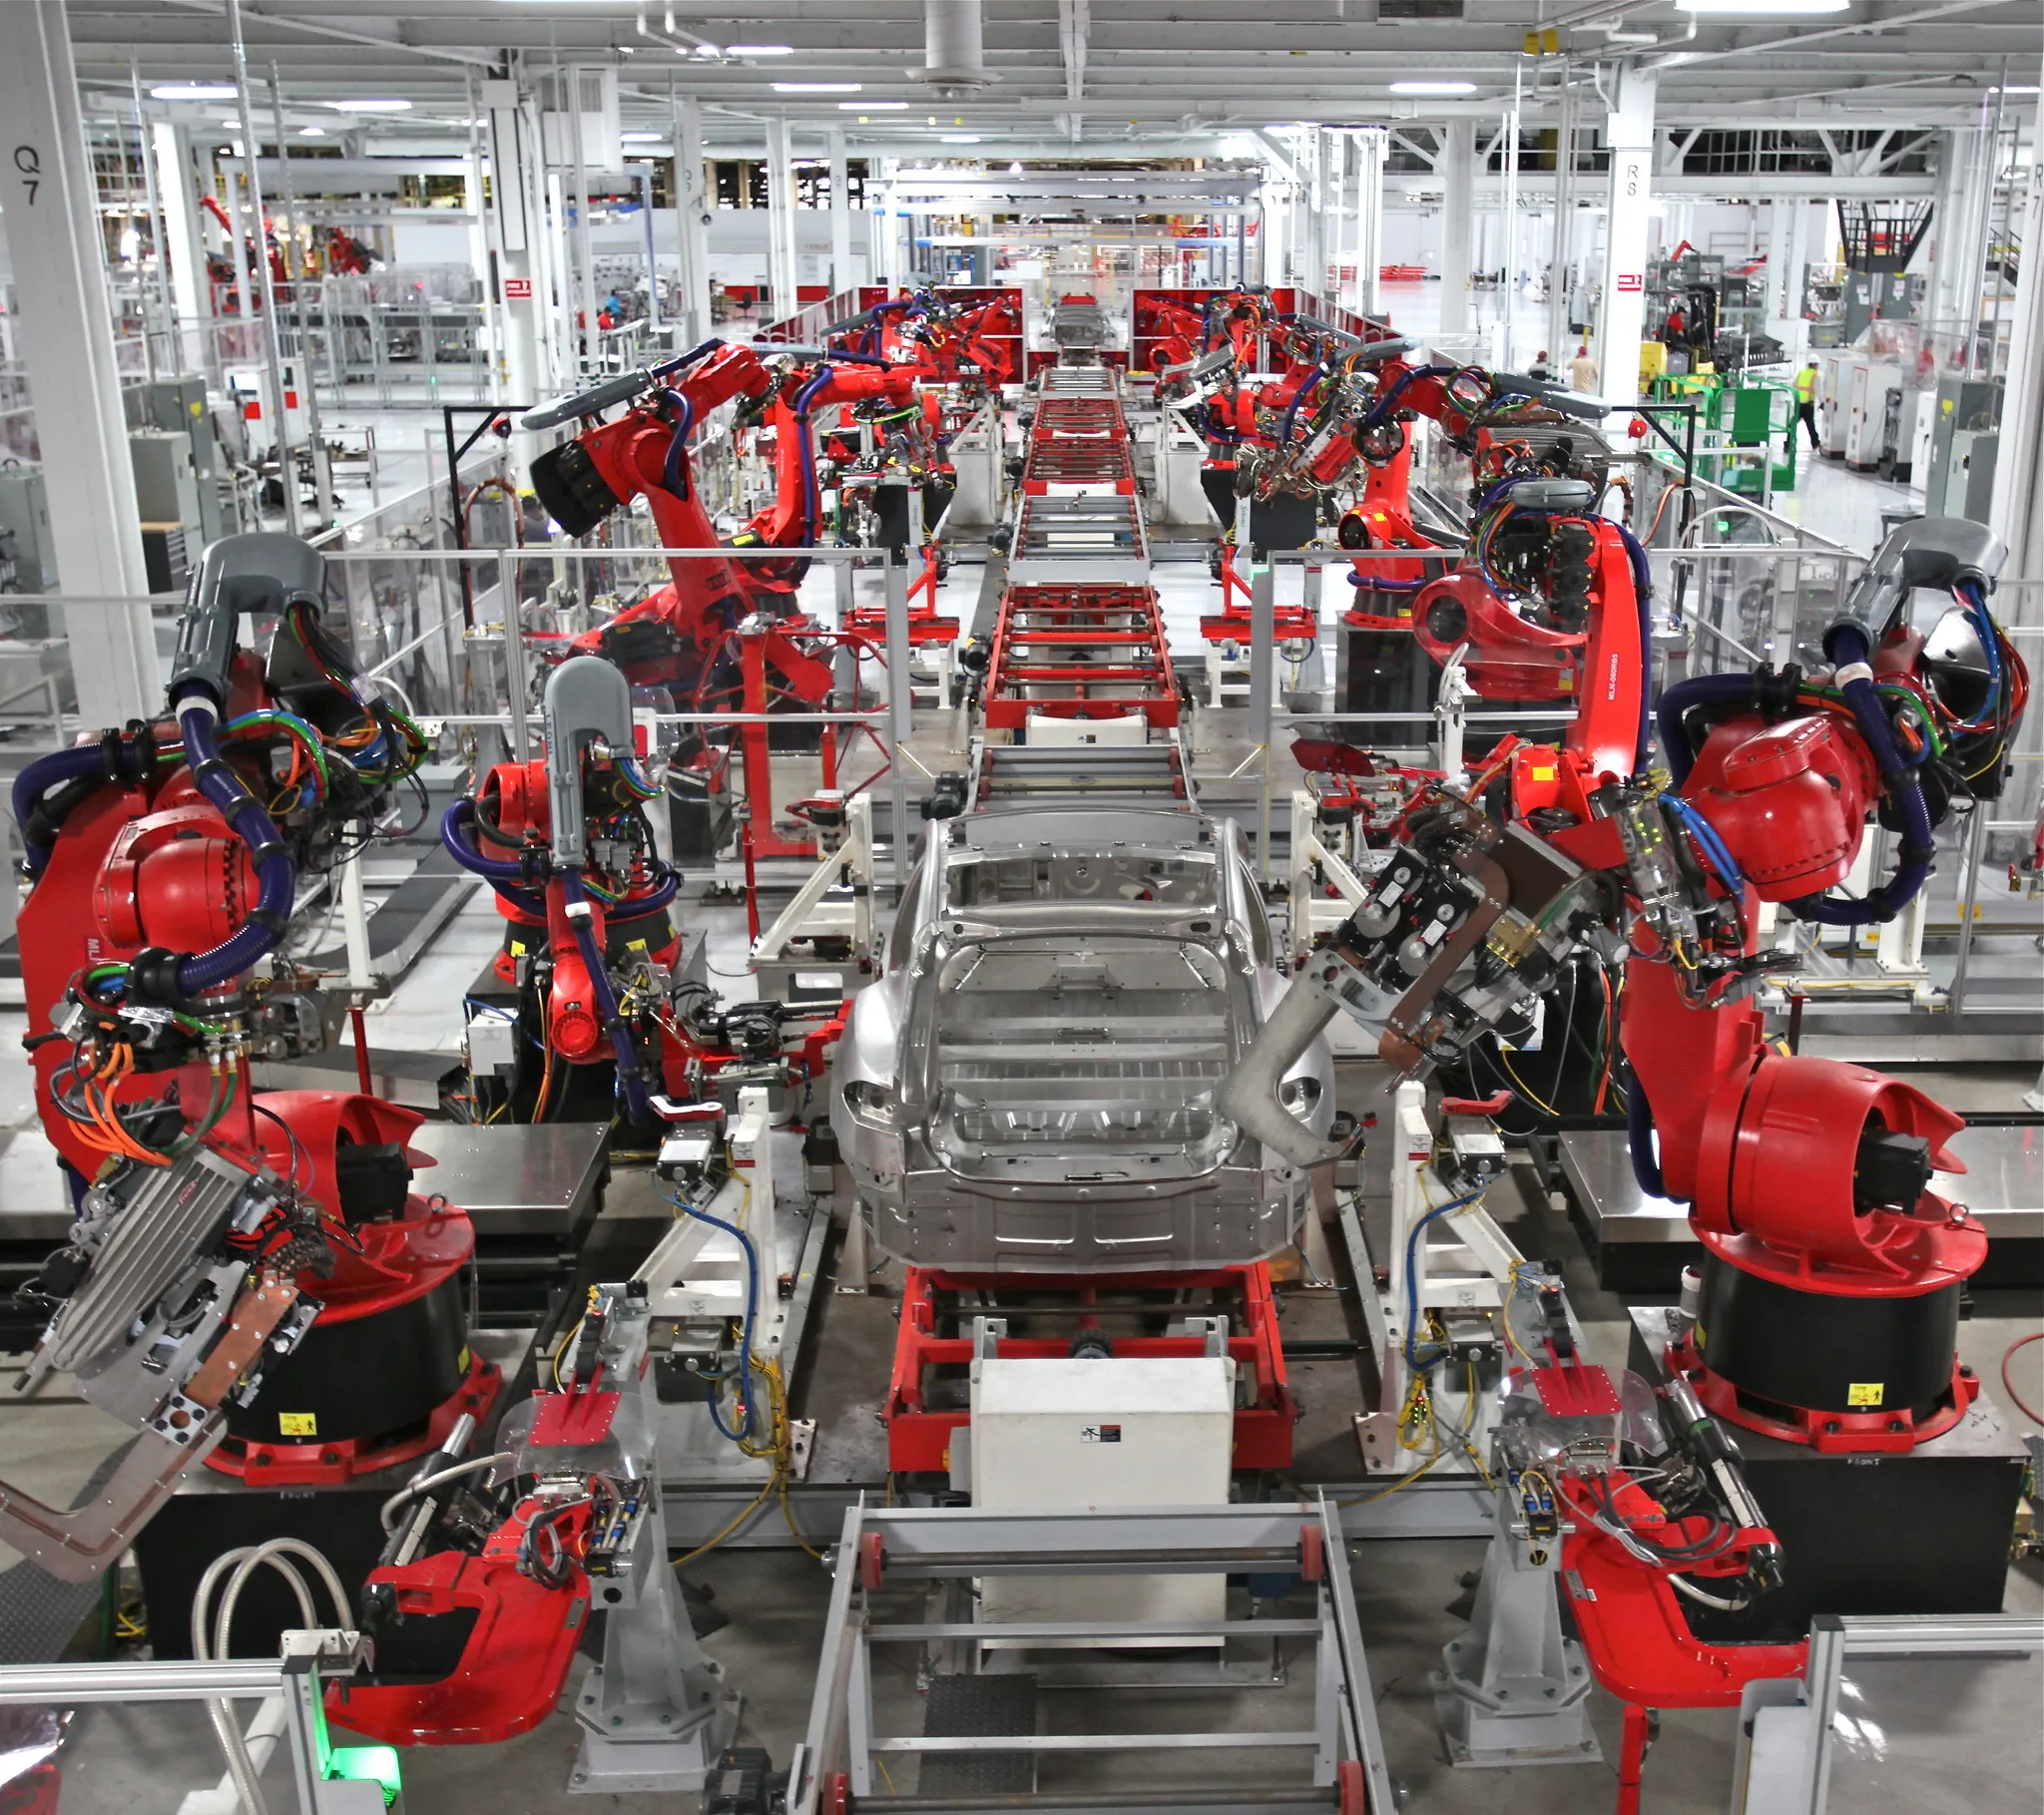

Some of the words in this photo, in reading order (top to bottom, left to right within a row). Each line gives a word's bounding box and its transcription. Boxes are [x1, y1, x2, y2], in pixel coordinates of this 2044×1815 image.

[14, 146, 41, 174] Q
[1627, 165, 1639, 179] R
[22, 180, 39, 206] 7
[1627, 182, 1637, 197] 8
